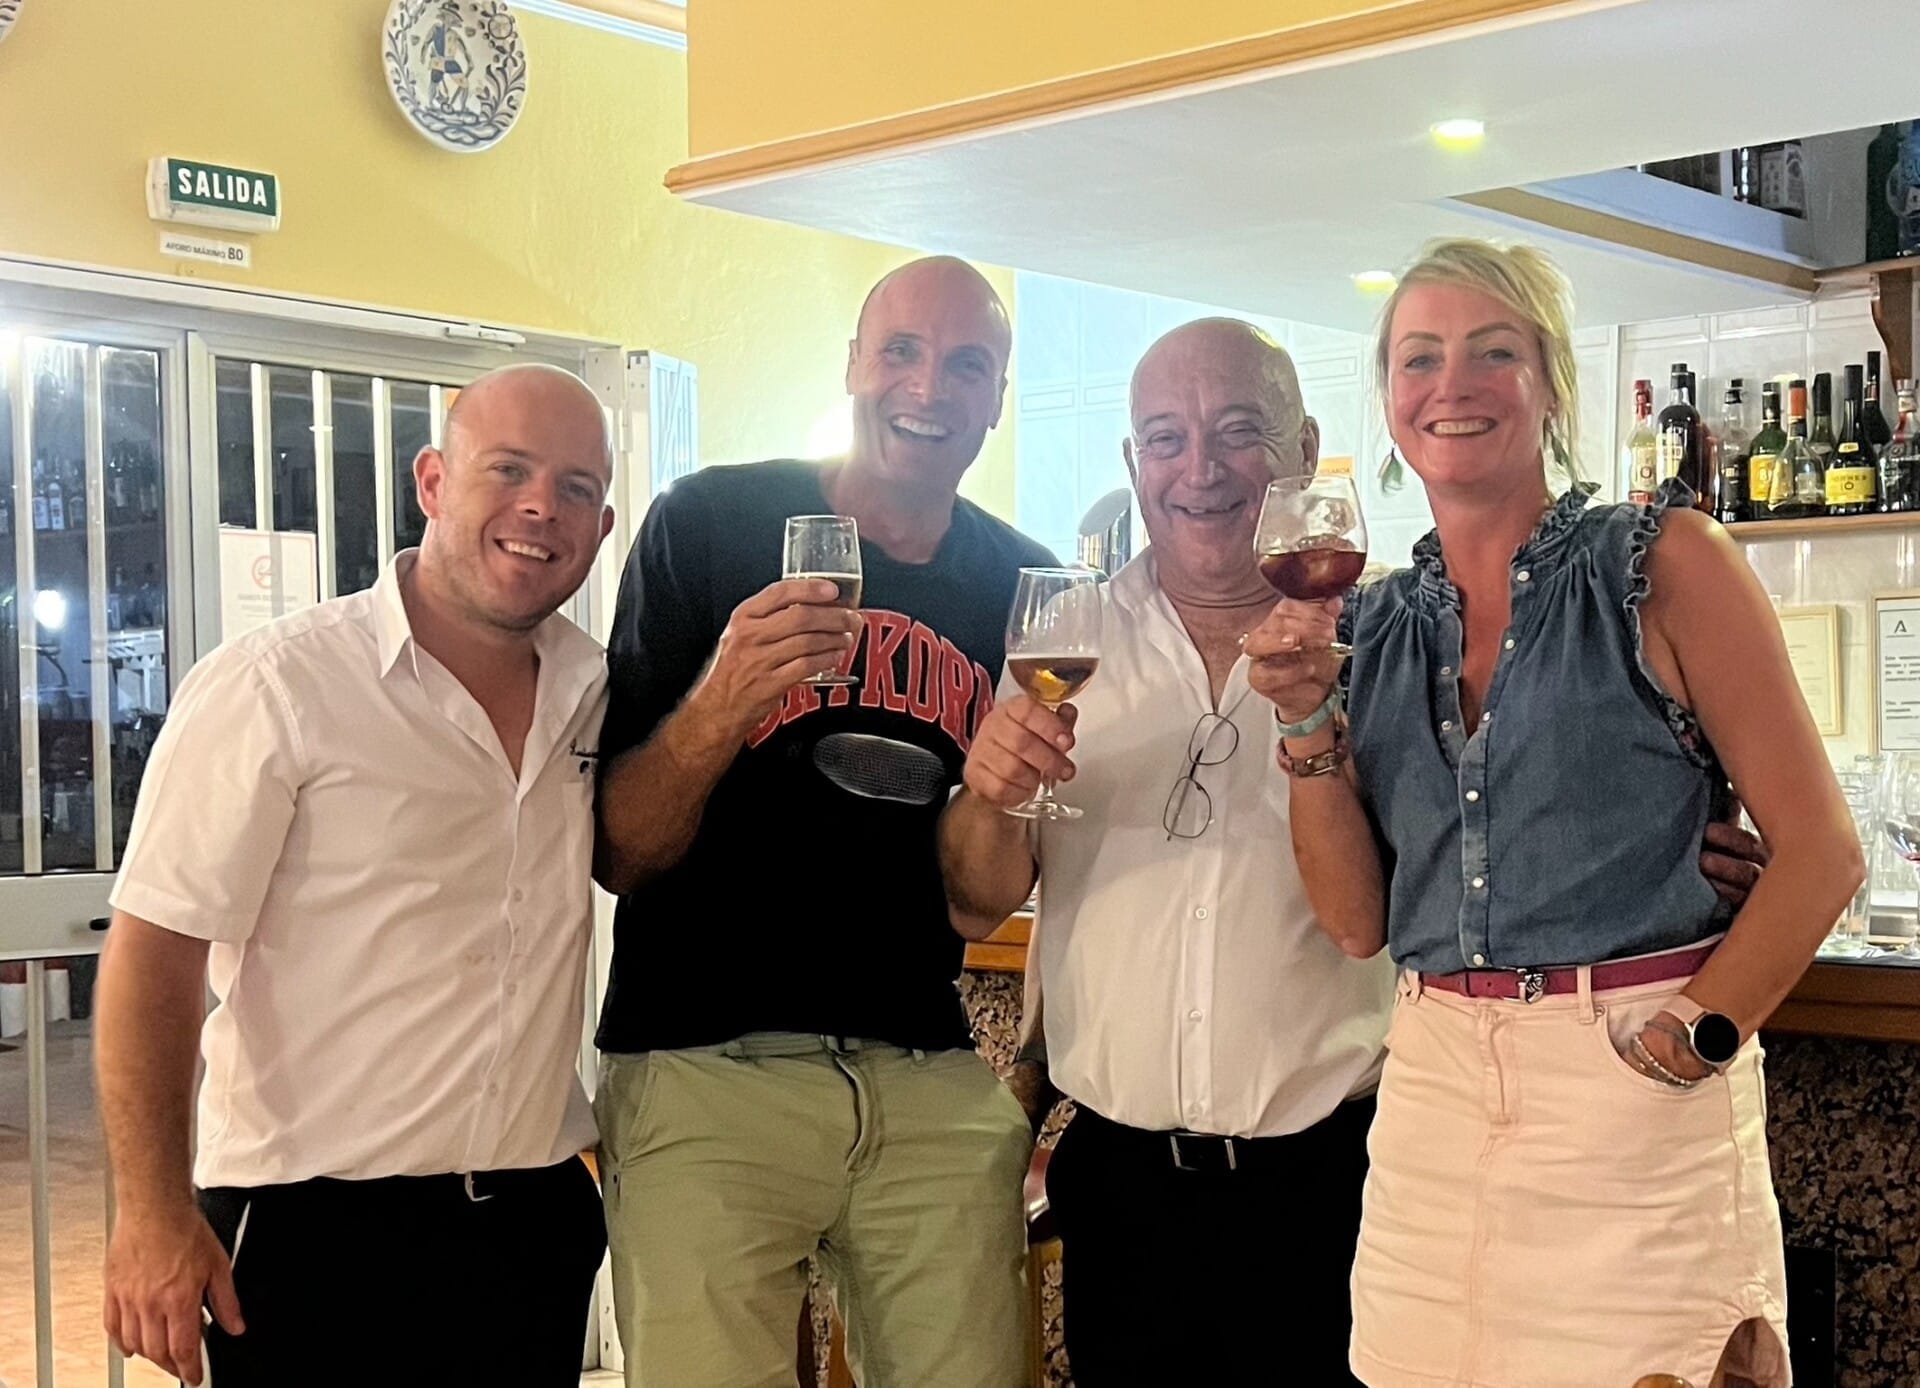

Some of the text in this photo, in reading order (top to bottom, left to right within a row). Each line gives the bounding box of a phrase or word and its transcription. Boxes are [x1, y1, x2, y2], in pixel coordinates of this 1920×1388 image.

[177, 167, 268, 207] SALIDA
[165, 241, 193, 253] AFORO
[228, 247, 244, 261] 80
